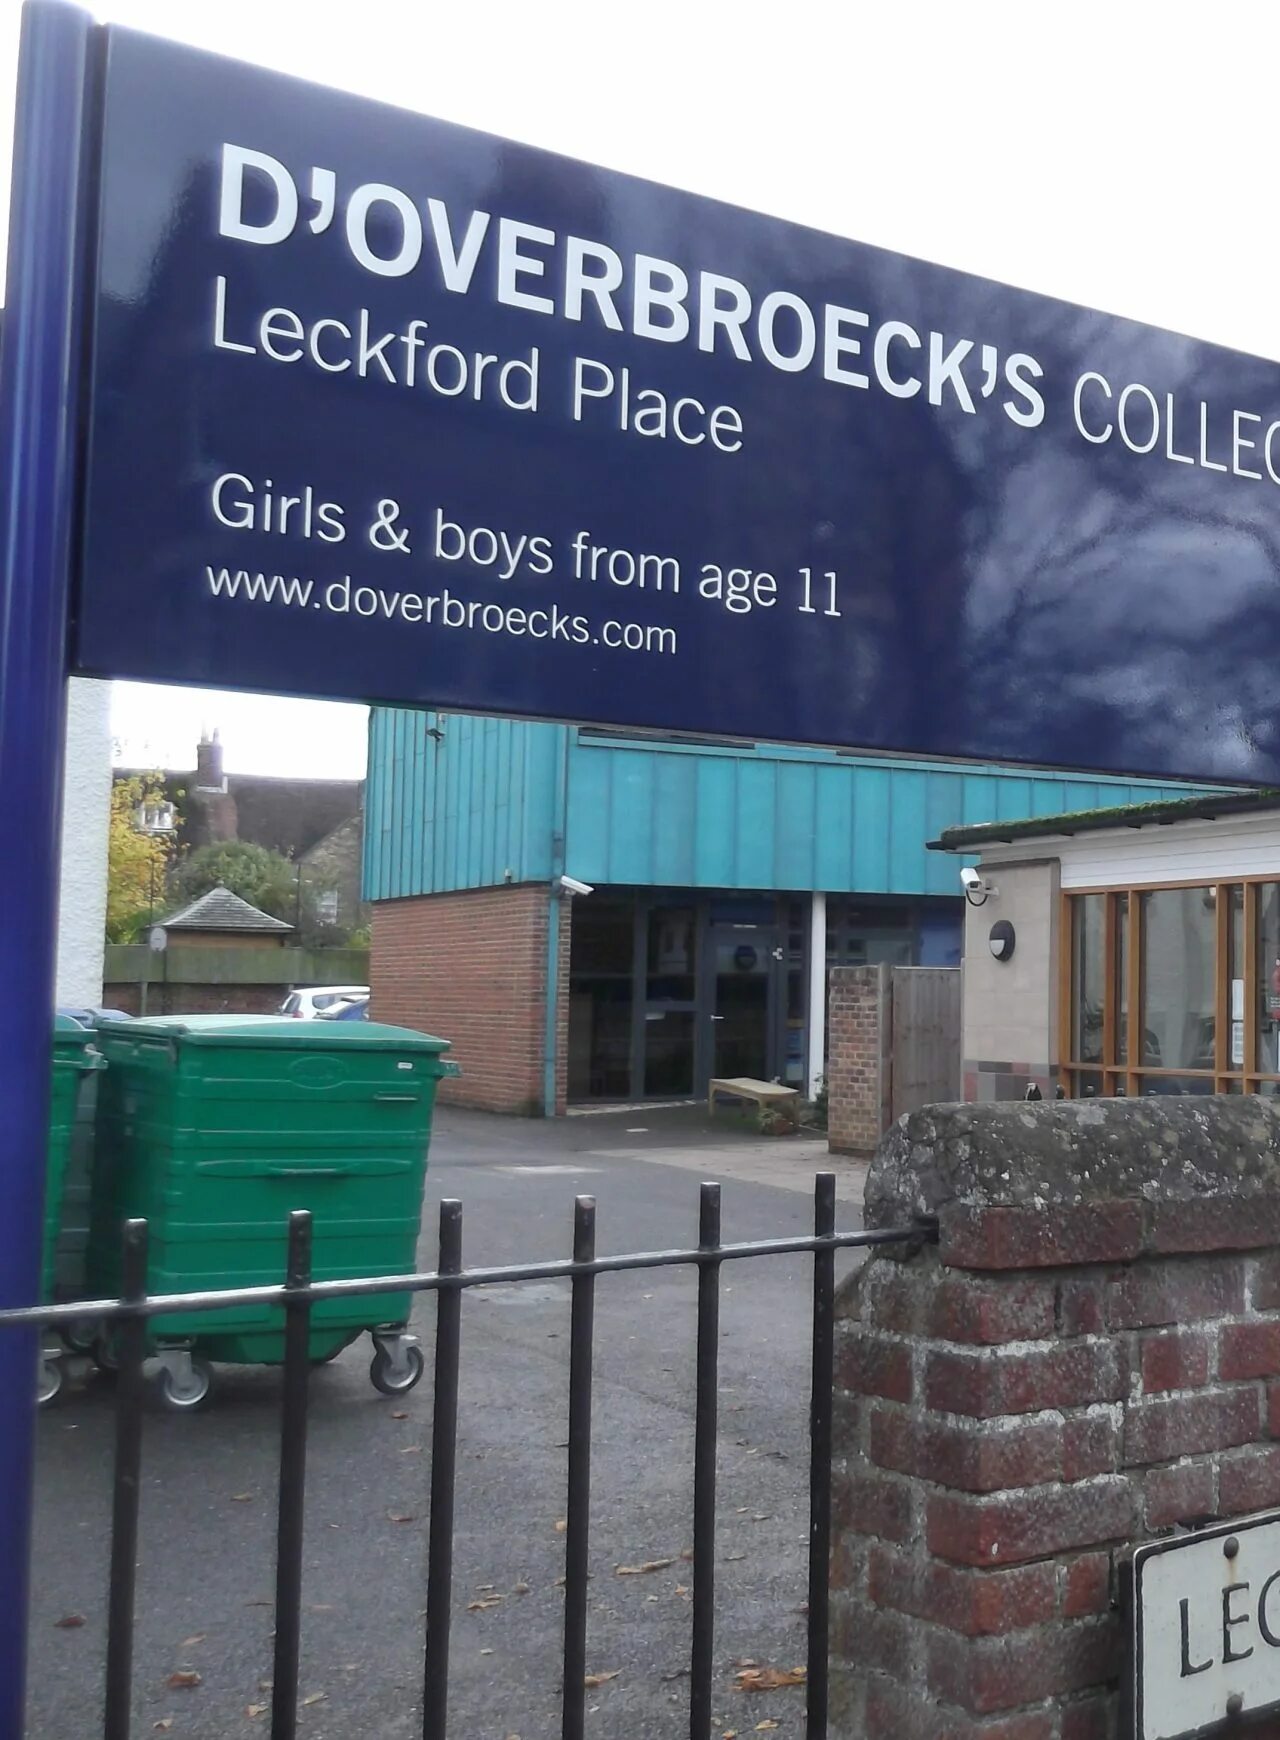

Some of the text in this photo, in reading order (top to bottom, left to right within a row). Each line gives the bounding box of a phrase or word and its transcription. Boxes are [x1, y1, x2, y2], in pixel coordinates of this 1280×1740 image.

[213, 275, 743, 453] Leckford Place
[205, 565, 677, 655] www.doverbroecks.com
[211, 472, 842, 617] Girls & boys from age 11
